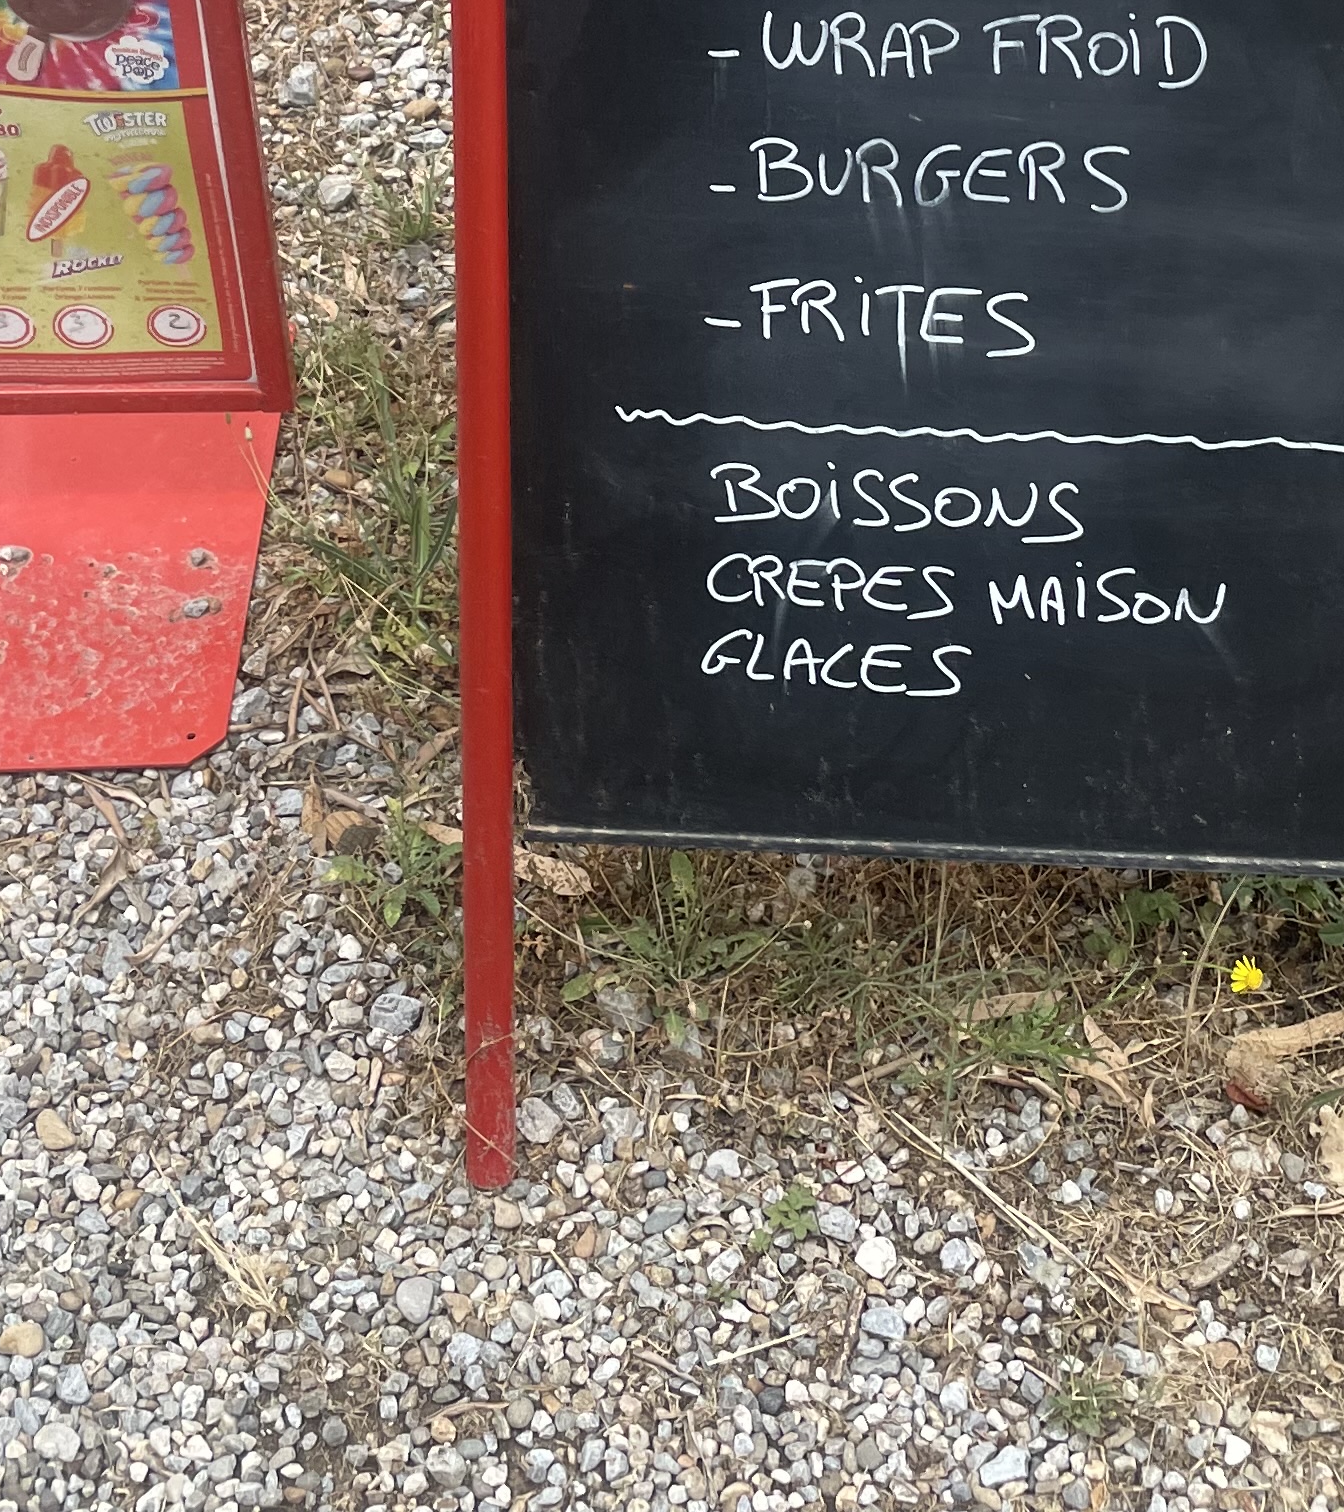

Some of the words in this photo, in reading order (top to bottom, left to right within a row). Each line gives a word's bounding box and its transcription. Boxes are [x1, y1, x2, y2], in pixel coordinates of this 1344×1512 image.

[115, 53, 160, 71] peace
[762, 10, 961, 80] WRAP
[33, 182, 85, 235] INDISPONIBLE
[167, 311, 192, 331] 2
[706, 552, 957, 621] CREPES
[701, 628, 973, 698] GLACES
